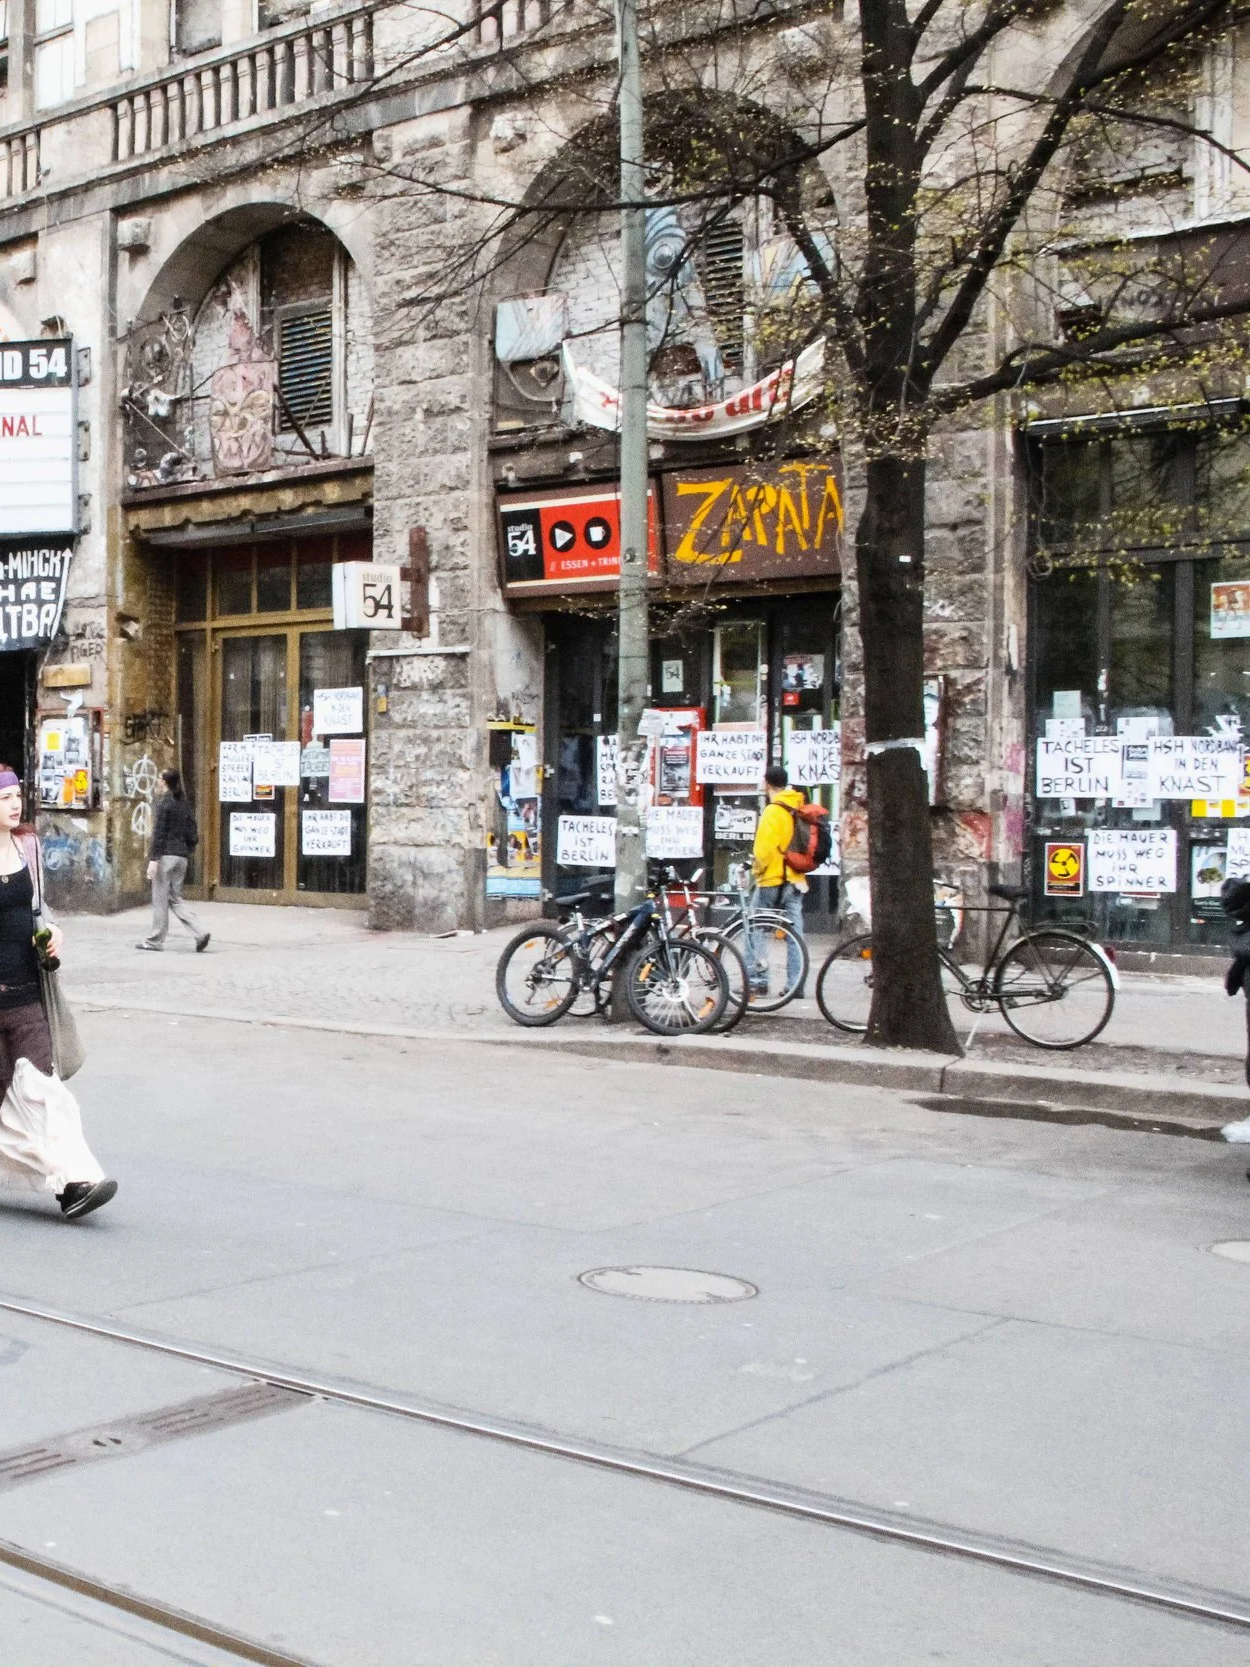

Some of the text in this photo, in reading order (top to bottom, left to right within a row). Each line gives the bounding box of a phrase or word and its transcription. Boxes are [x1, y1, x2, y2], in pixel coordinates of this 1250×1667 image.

[29, 348, 67, 379] 54
[675, 461, 845, 565] ZAPATA
[507, 523, 533, 532] studio
[507, 530, 537, 557] 54
[561, 559, 588, 570] ESSEN
[598, 556, 620, 567] TRIN
[362, 572, 392, 583] studio
[363, 583, 394, 619] 54
[721, 734, 748, 745] HABT
[1042, 739, 1119, 754] TACHELES
[1153, 739, 1184, 755] HSH
[700, 749, 737, 760] GANZE
[701, 765, 760, 776] VERKAUFT
[1064, 757, 1094, 774] IST
[1175, 757, 1218, 771] IN DEN
[1042, 776, 1108, 794] BERLIN
[1159, 775, 1227, 793] KNAST
[562, 820, 613, 836] TACHELES
[715, 832, 755, 840] BERLIN
[1096, 848, 1164, 861] MUSS WEG
